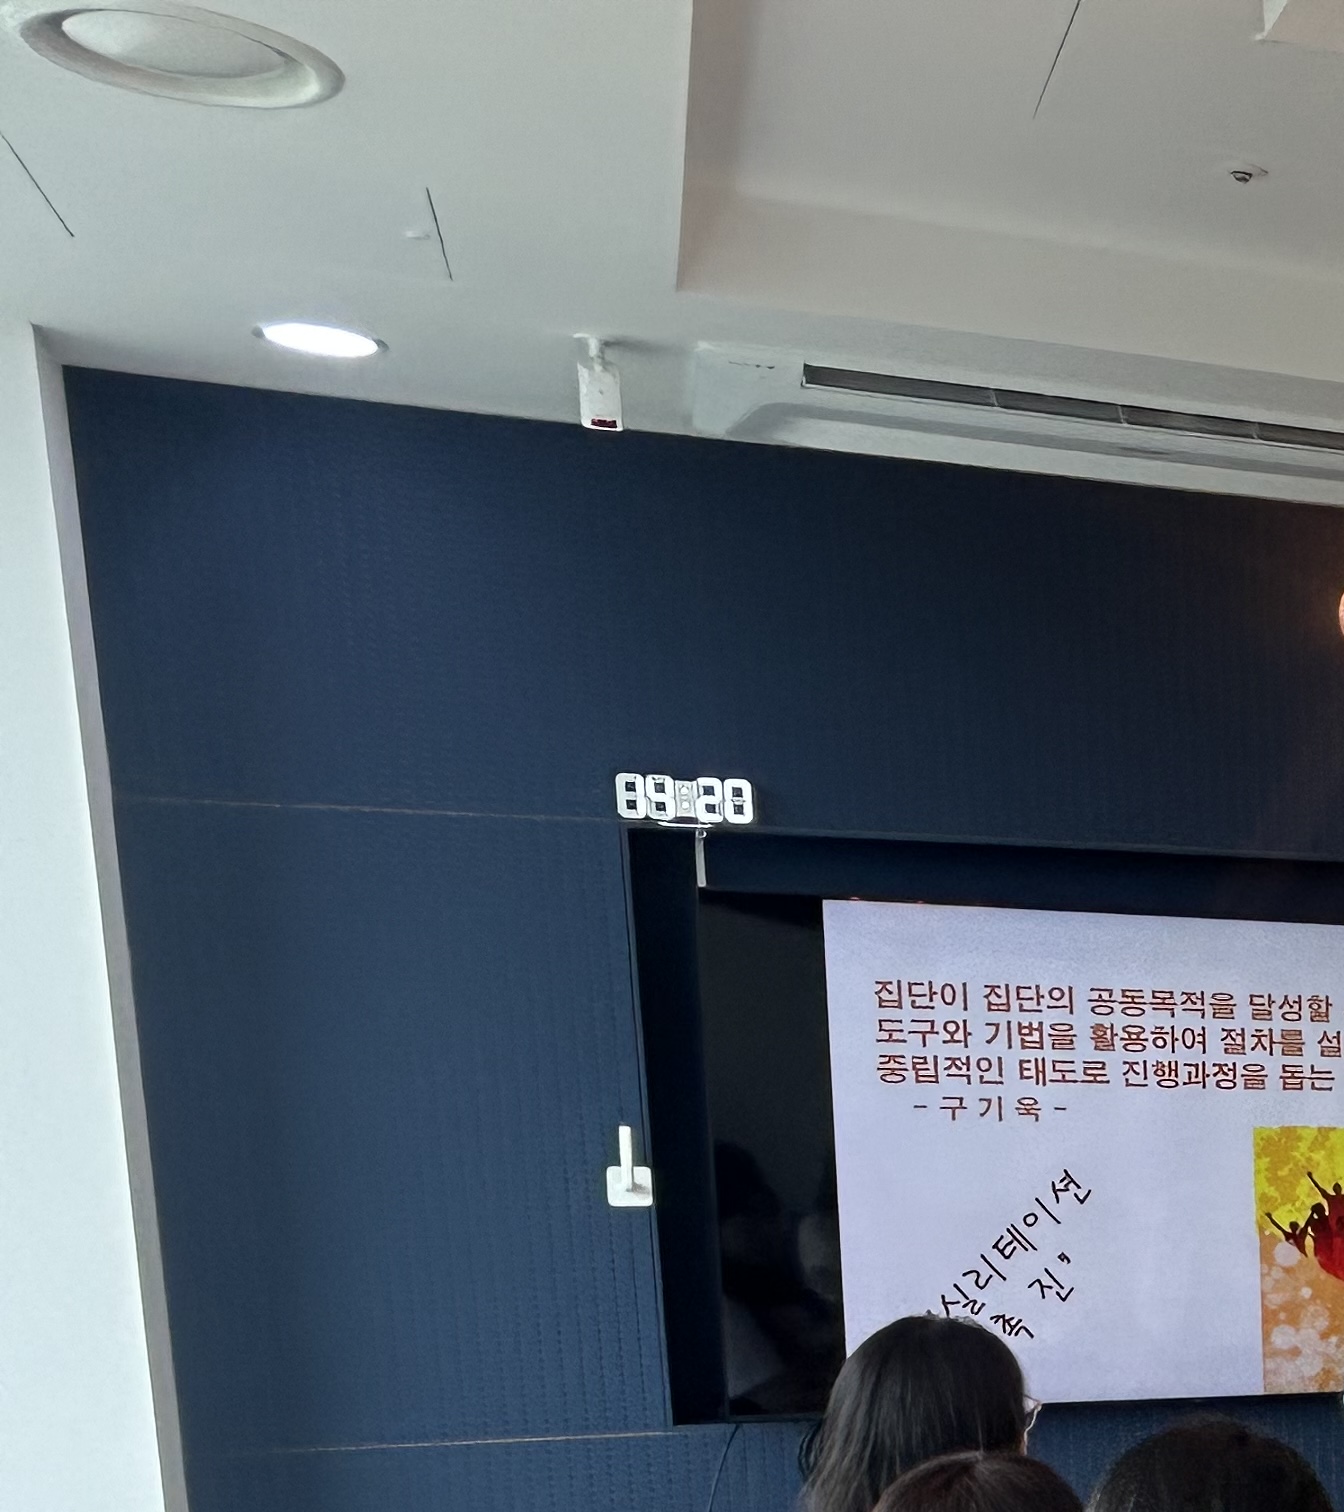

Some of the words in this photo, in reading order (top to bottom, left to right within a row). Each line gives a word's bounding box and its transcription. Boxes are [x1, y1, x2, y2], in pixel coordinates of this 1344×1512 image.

[874, 979, 968, 1011] 집단이
[983, 983, 1074, 1015] 집단의
[1087, 987, 1237, 1020] 공동목적을
[1249, 992, 1333, 1023] 달성할
[876, 1018, 972, 1048] 도구와
[984, 1020, 1077, 1051] 기법을
[1090, 1021, 1207, 1055] 활용하여
[1220, 1027, 1305, 1056] 절차를
[876, 1054, 1004, 1085] 중립적인
[1018, 1057, 1110, 1086] 태도로
[1122, 1059, 1269, 1091] 진행과정을
[1279, 1063, 1335, 1092] 돕는
[941, 1168, 1092, 1317] 실리테이션
